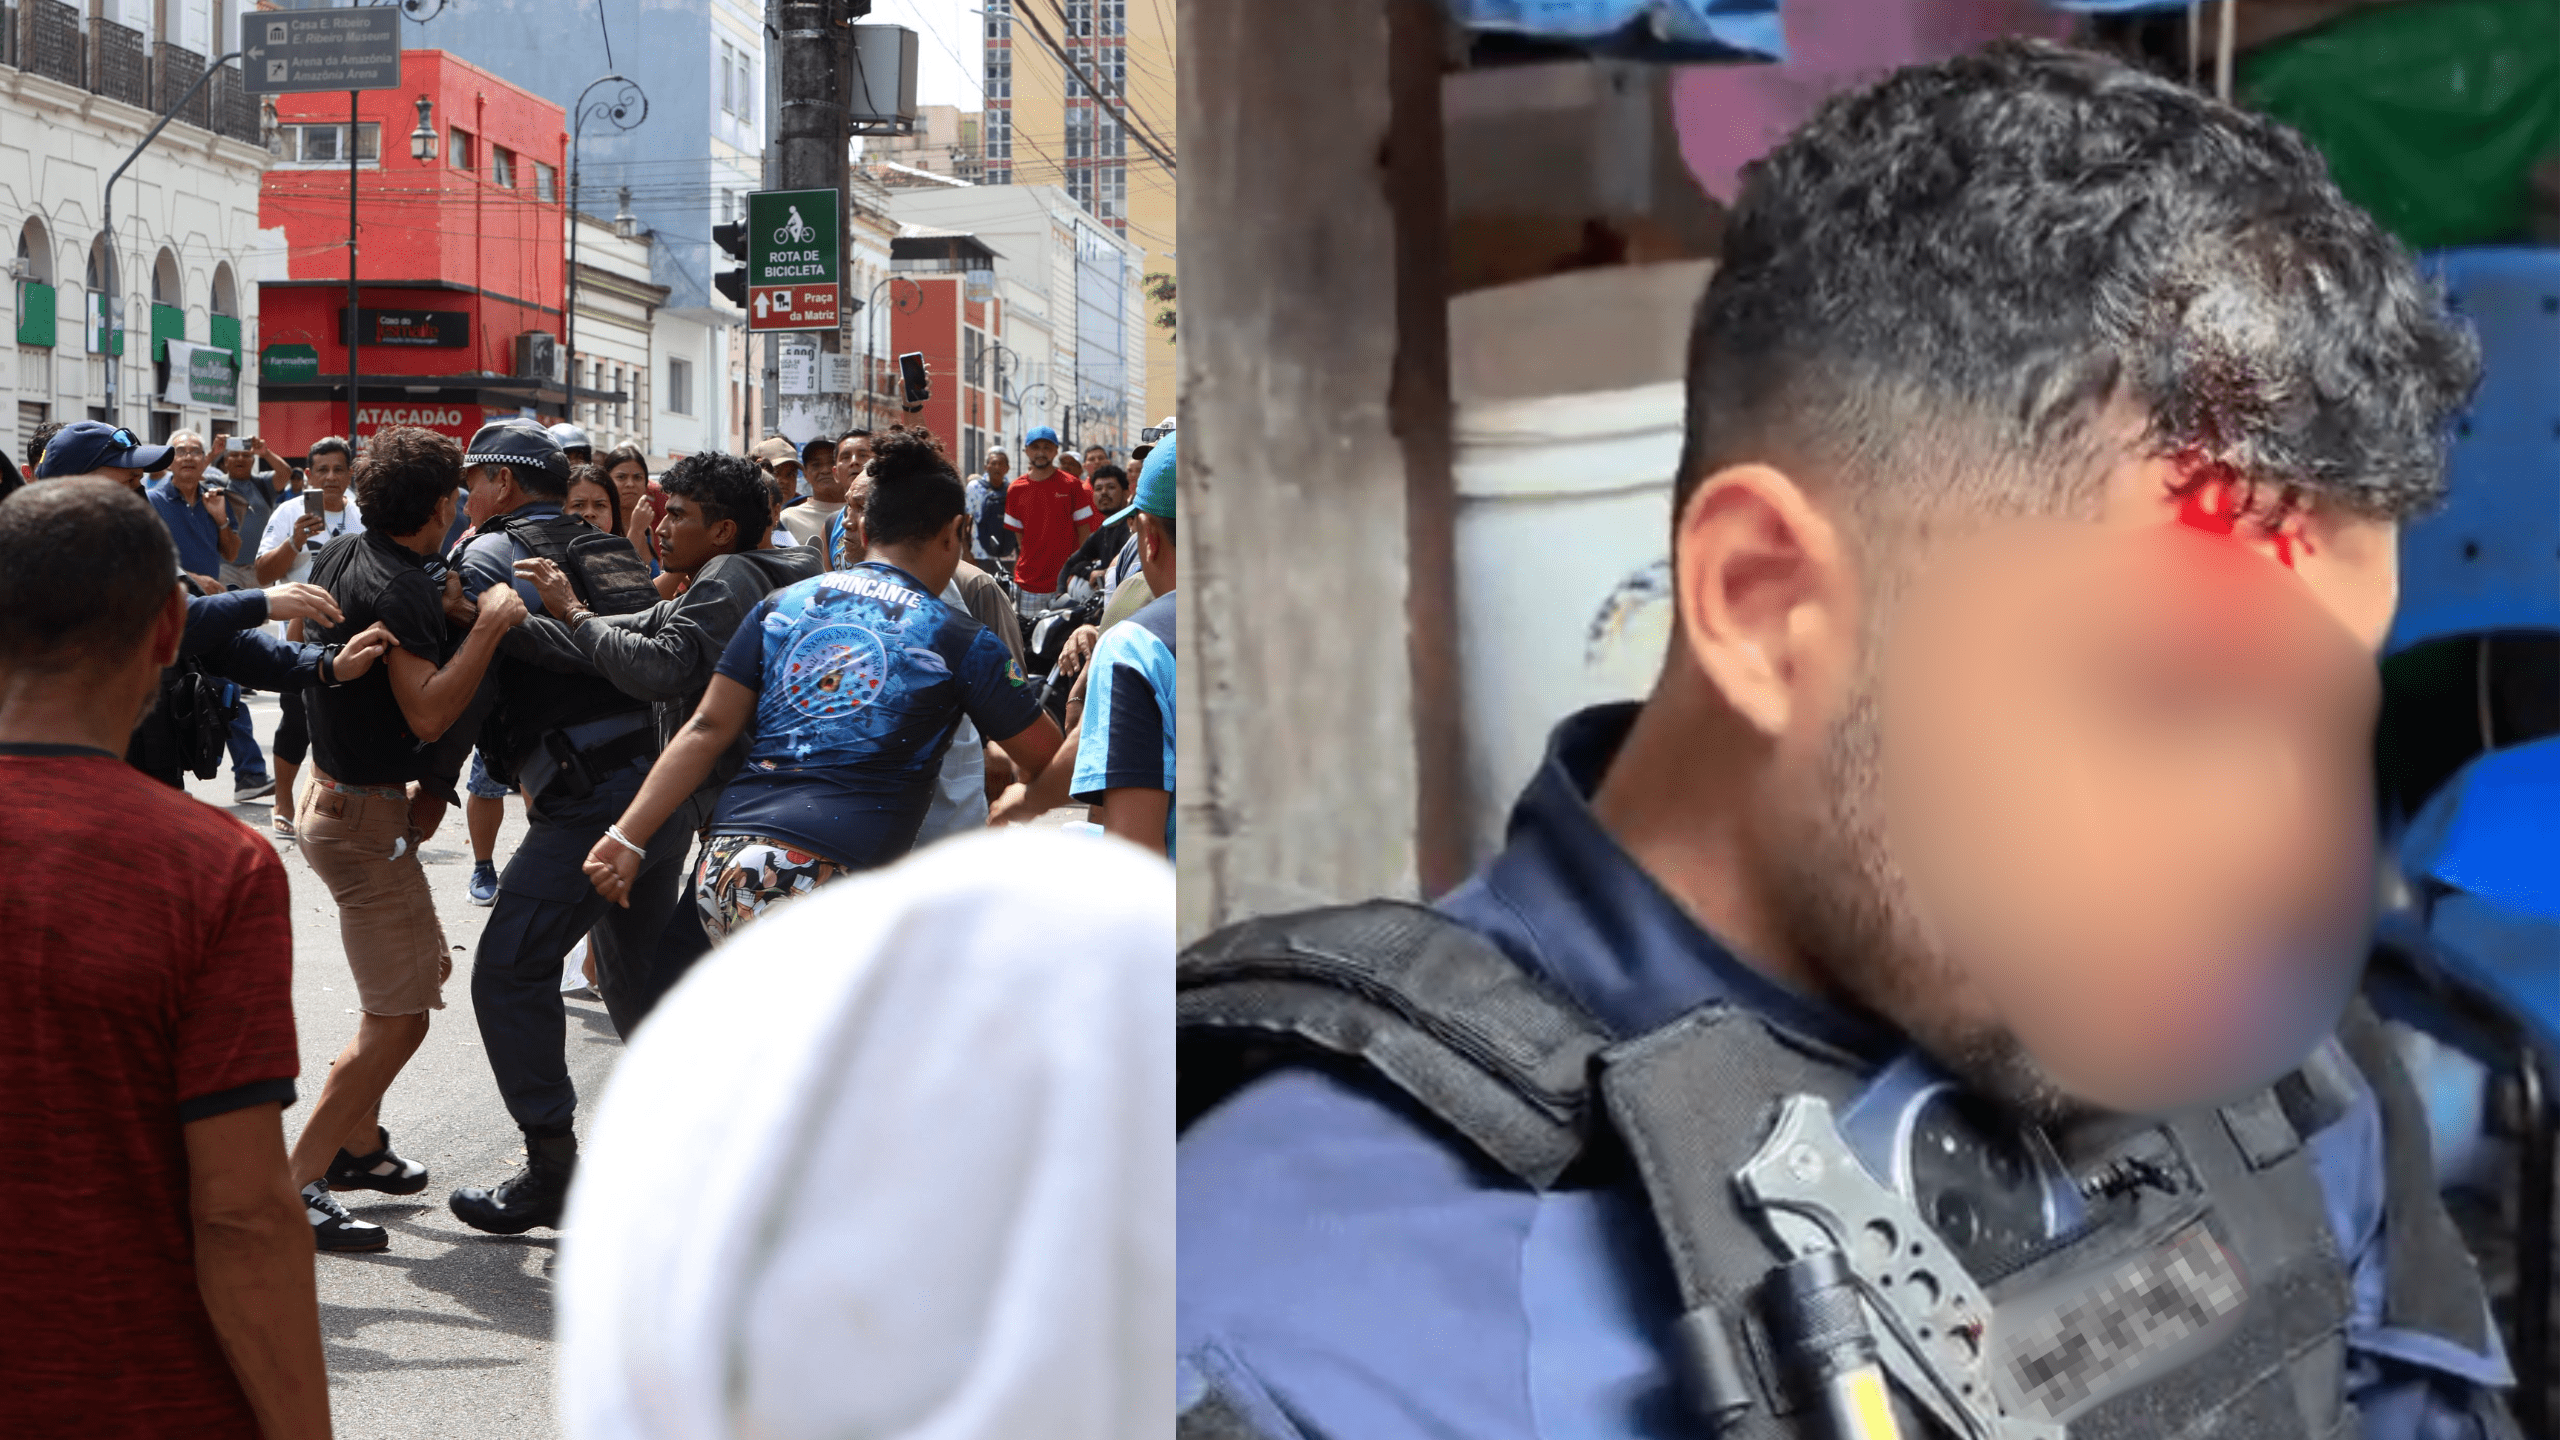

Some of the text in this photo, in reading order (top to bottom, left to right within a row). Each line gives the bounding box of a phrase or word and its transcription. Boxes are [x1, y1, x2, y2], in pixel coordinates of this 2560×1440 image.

[291, 17, 371, 30] Casa E. Ribeiro
[292, 31, 391, 45] E. Ribeiro Museum
[291, 53, 392, 67] Arena da Amazônia
[293, 68, 378, 81] Amazônia Arena
[769, 249, 820, 263] ROTA DE
[764, 263, 825, 278] BICICLETA
[804, 292, 833, 305] Praça
[789, 309, 835, 321] da Matriz
[356, 405, 463, 426] ATACADÃO
[820, 573, 925, 608] BRINCANTE
